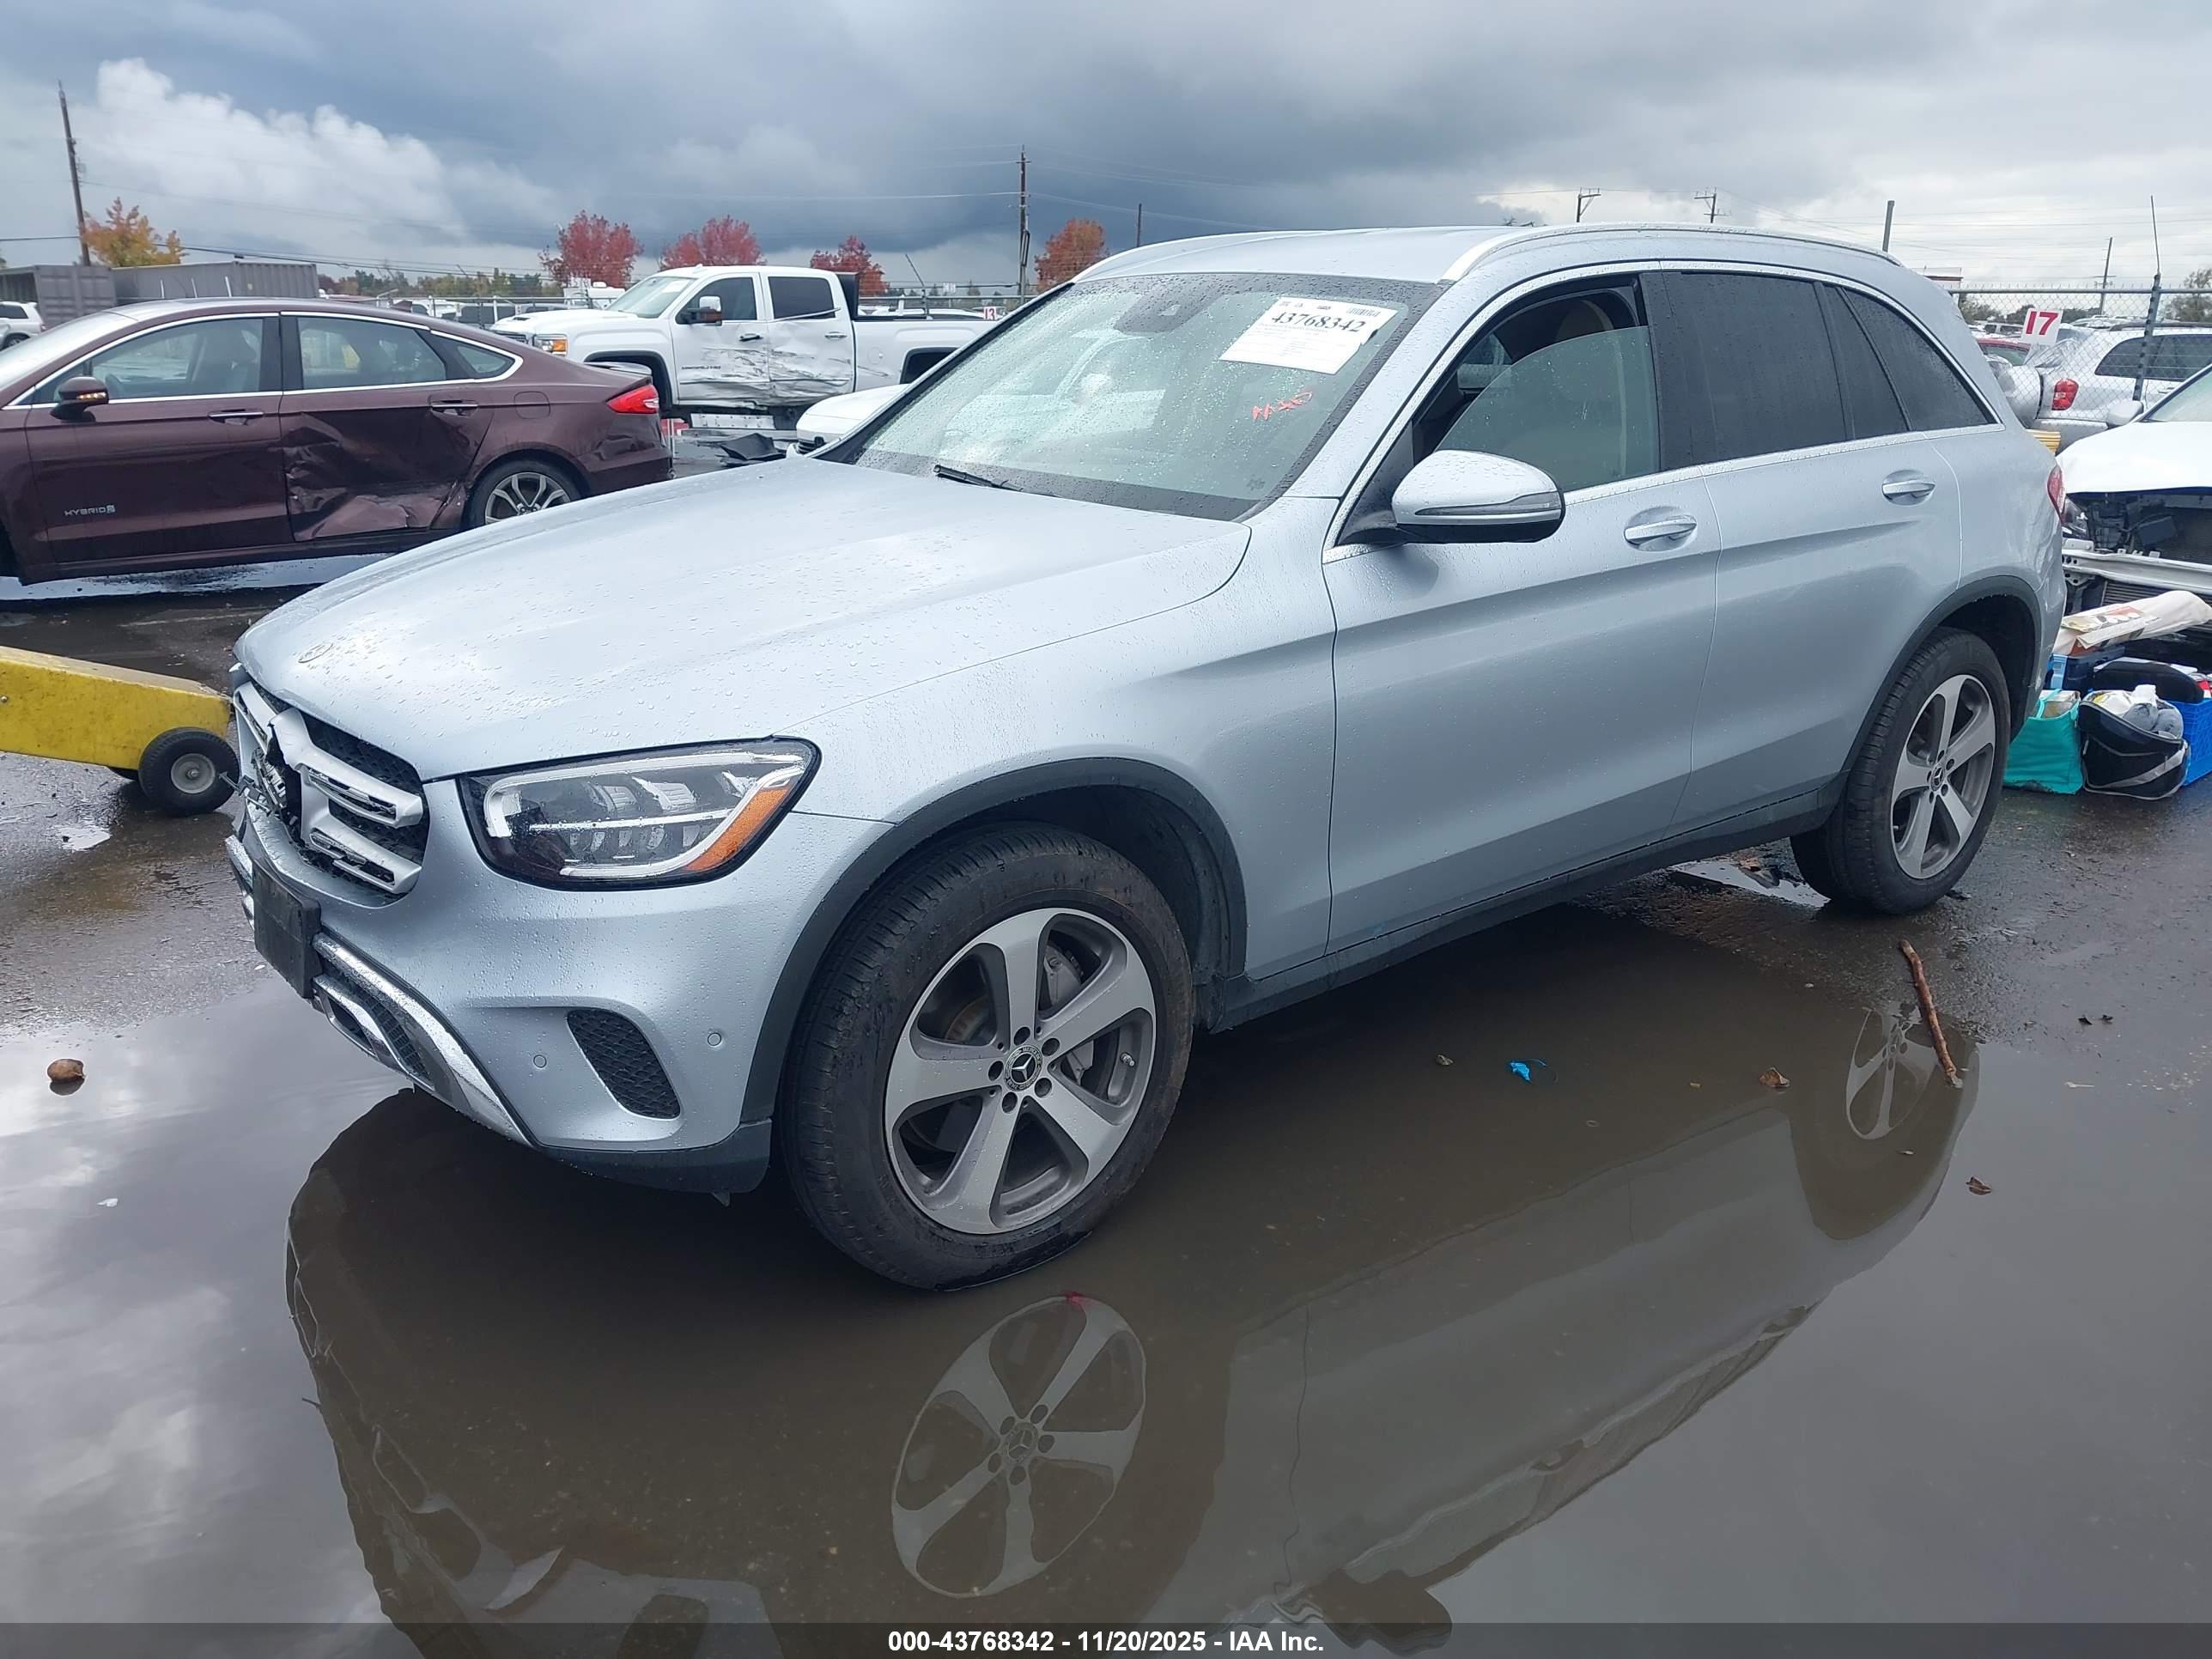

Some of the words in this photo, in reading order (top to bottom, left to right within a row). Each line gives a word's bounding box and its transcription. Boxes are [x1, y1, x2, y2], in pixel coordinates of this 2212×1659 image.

[1272, 312, 1366, 332] 43768342
[2026, 311, 2058, 335] 17
[64, 507, 106, 516] HYBRID
